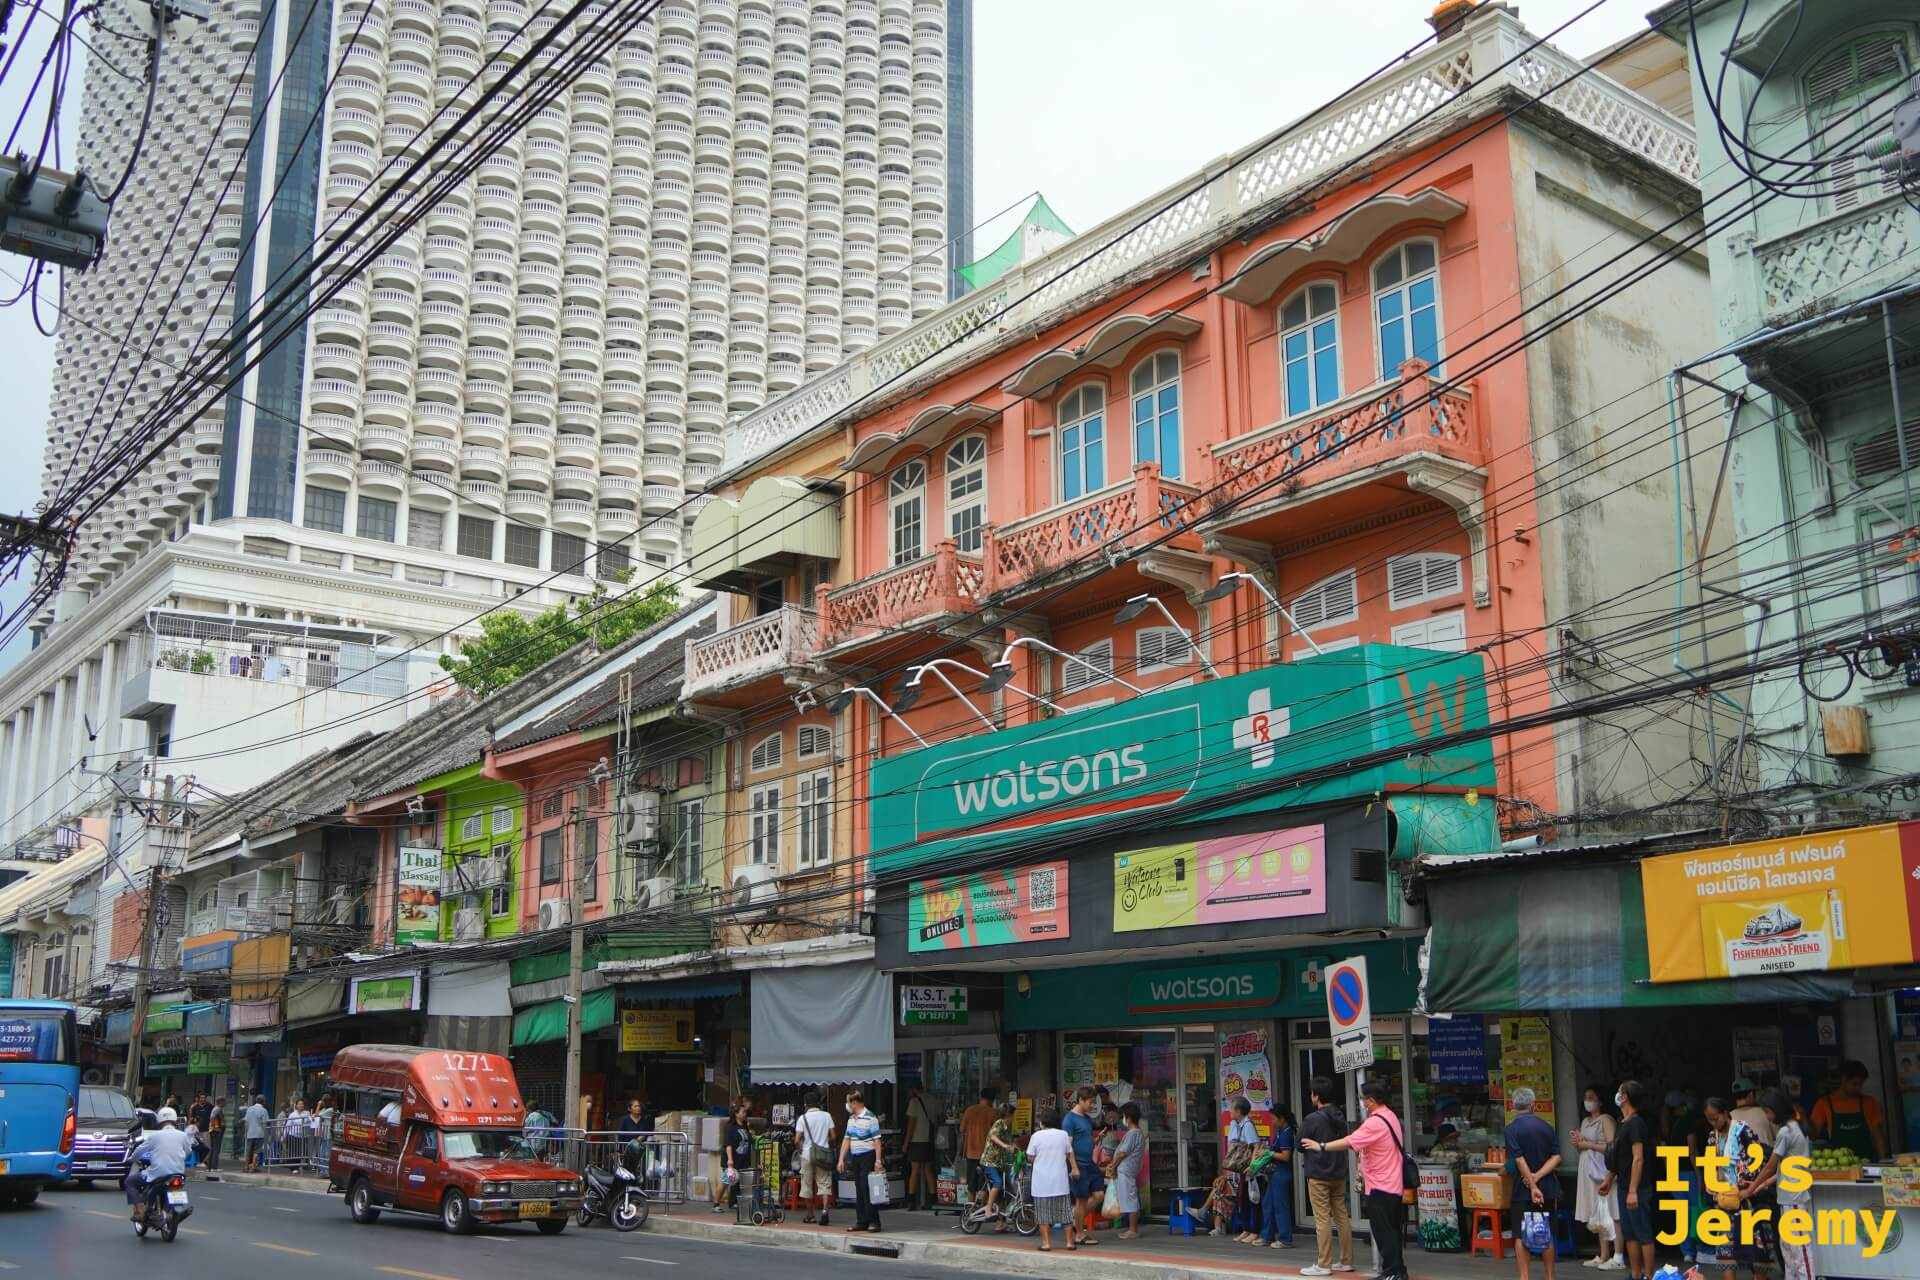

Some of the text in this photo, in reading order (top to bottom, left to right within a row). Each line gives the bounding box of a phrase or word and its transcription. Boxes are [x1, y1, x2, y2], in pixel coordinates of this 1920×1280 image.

[953, 743, 1148, 816] watsons
[404, 852, 438, 867] Thai
[401, 870, 440, 882] Massage
[1124, 865, 1161, 887] Watsons
[1138, 880, 1163, 901] Club
[926, 918, 955, 939] ONLINE
[1732, 941, 1820, 961] FISHERMAN'S FRIEND
[1760, 960, 1795, 972] ANISEED
[910, 988, 946, 1001] K.S.T.
[1150, 975, 1254, 1001] watsons
[443, 1053, 494, 1072] 1271
[477, 1116, 492, 1124] 1271
